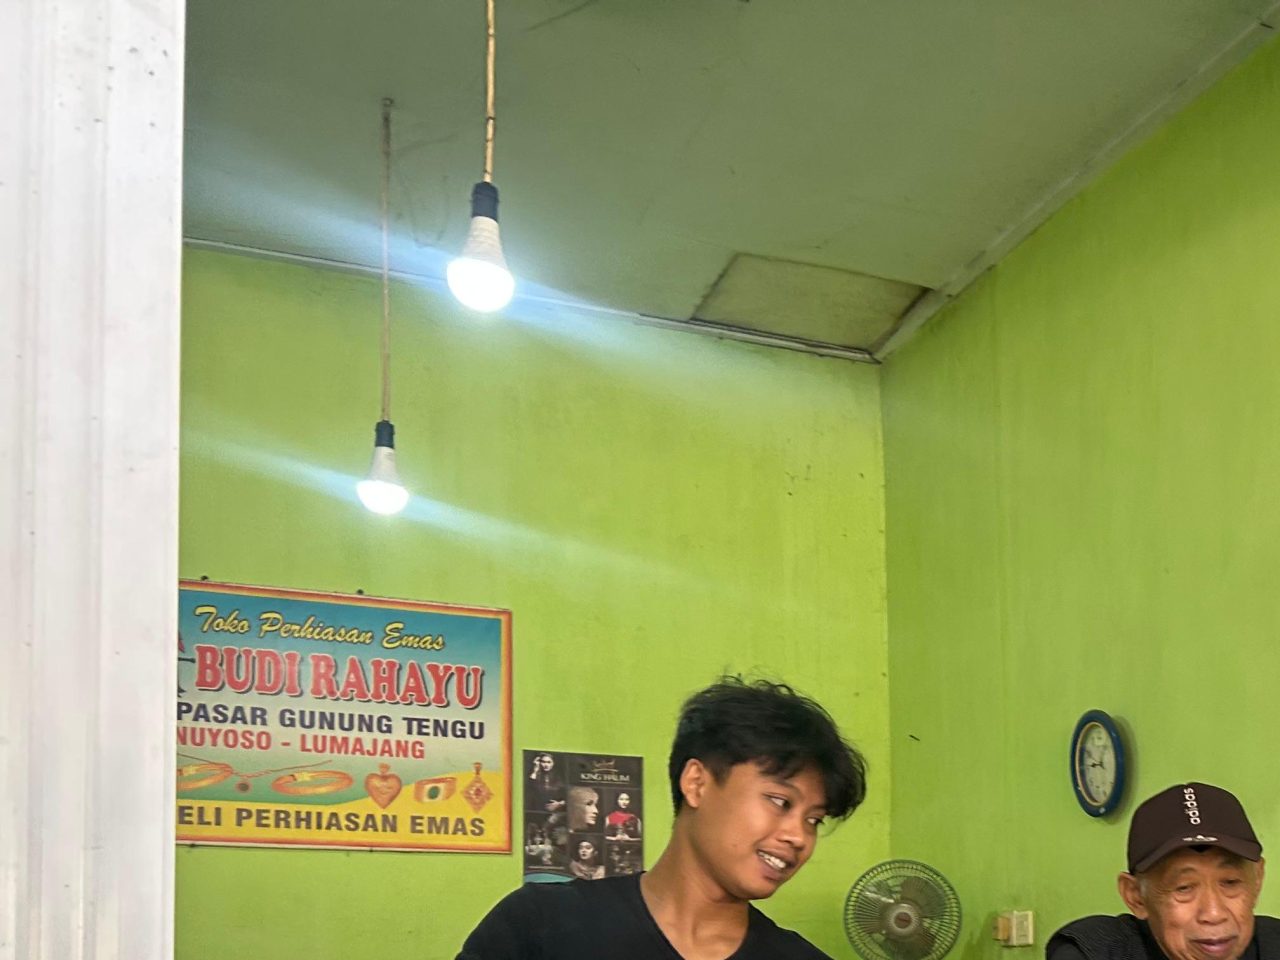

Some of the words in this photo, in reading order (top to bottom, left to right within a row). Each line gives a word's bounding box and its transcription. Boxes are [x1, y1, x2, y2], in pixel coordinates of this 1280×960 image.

[194, 605, 250, 633] Toko
[258, 611, 373, 644] Perhiasan
[382, 622, 445, 650] Emas
[194, 644, 301, 696] BUDI
[310, 653, 483, 708] RAHAYU
[177, 701, 268, 726] PASAR
[279, 708, 393, 734] GUNUNG
[402, 716, 485, 740] TENGU
[300, 733, 424, 759] LUMAJANG
[235, 808, 398, 833] PERHIASAN
[409, 815, 485, 837] EMAS
[1183, 787, 1201, 825] adidas
